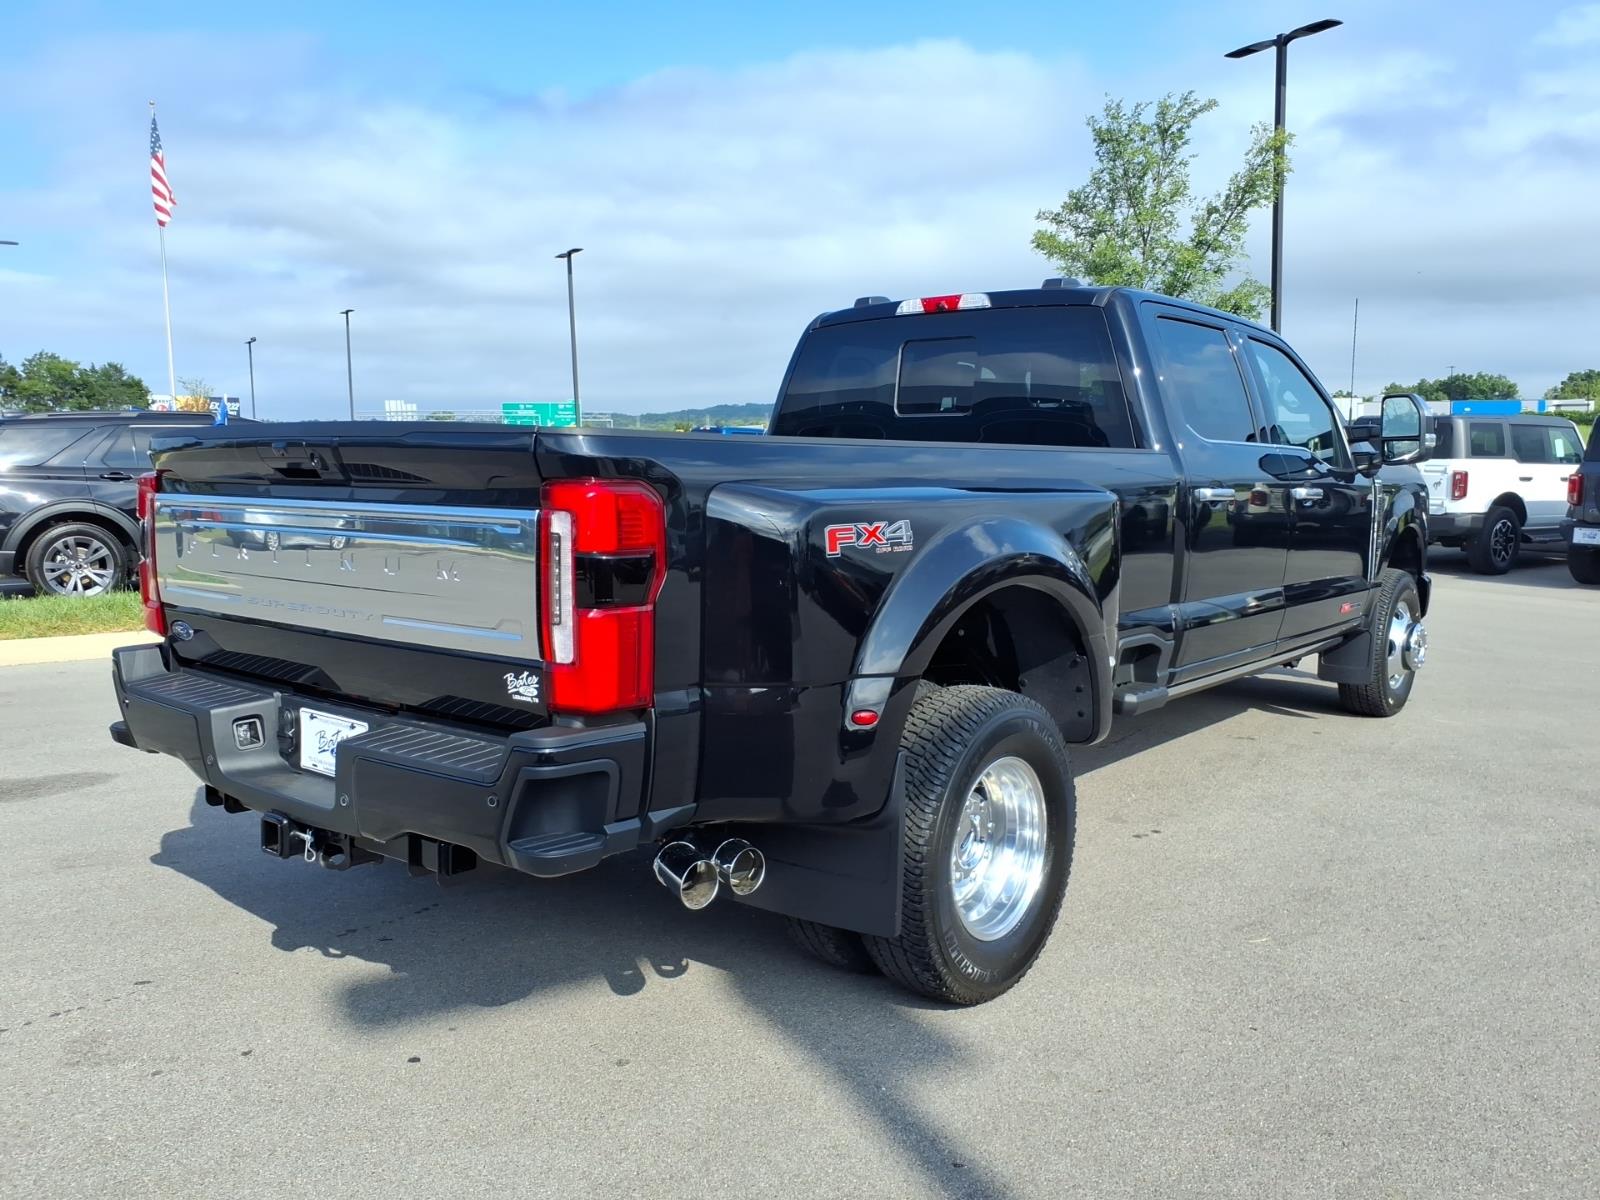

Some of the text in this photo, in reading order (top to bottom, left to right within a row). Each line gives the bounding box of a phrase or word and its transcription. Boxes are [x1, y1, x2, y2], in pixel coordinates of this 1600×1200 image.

[824, 519, 914, 558] FX4
[186, 535, 461, 582] PLATINUM
[503, 671, 540, 689] Bates
